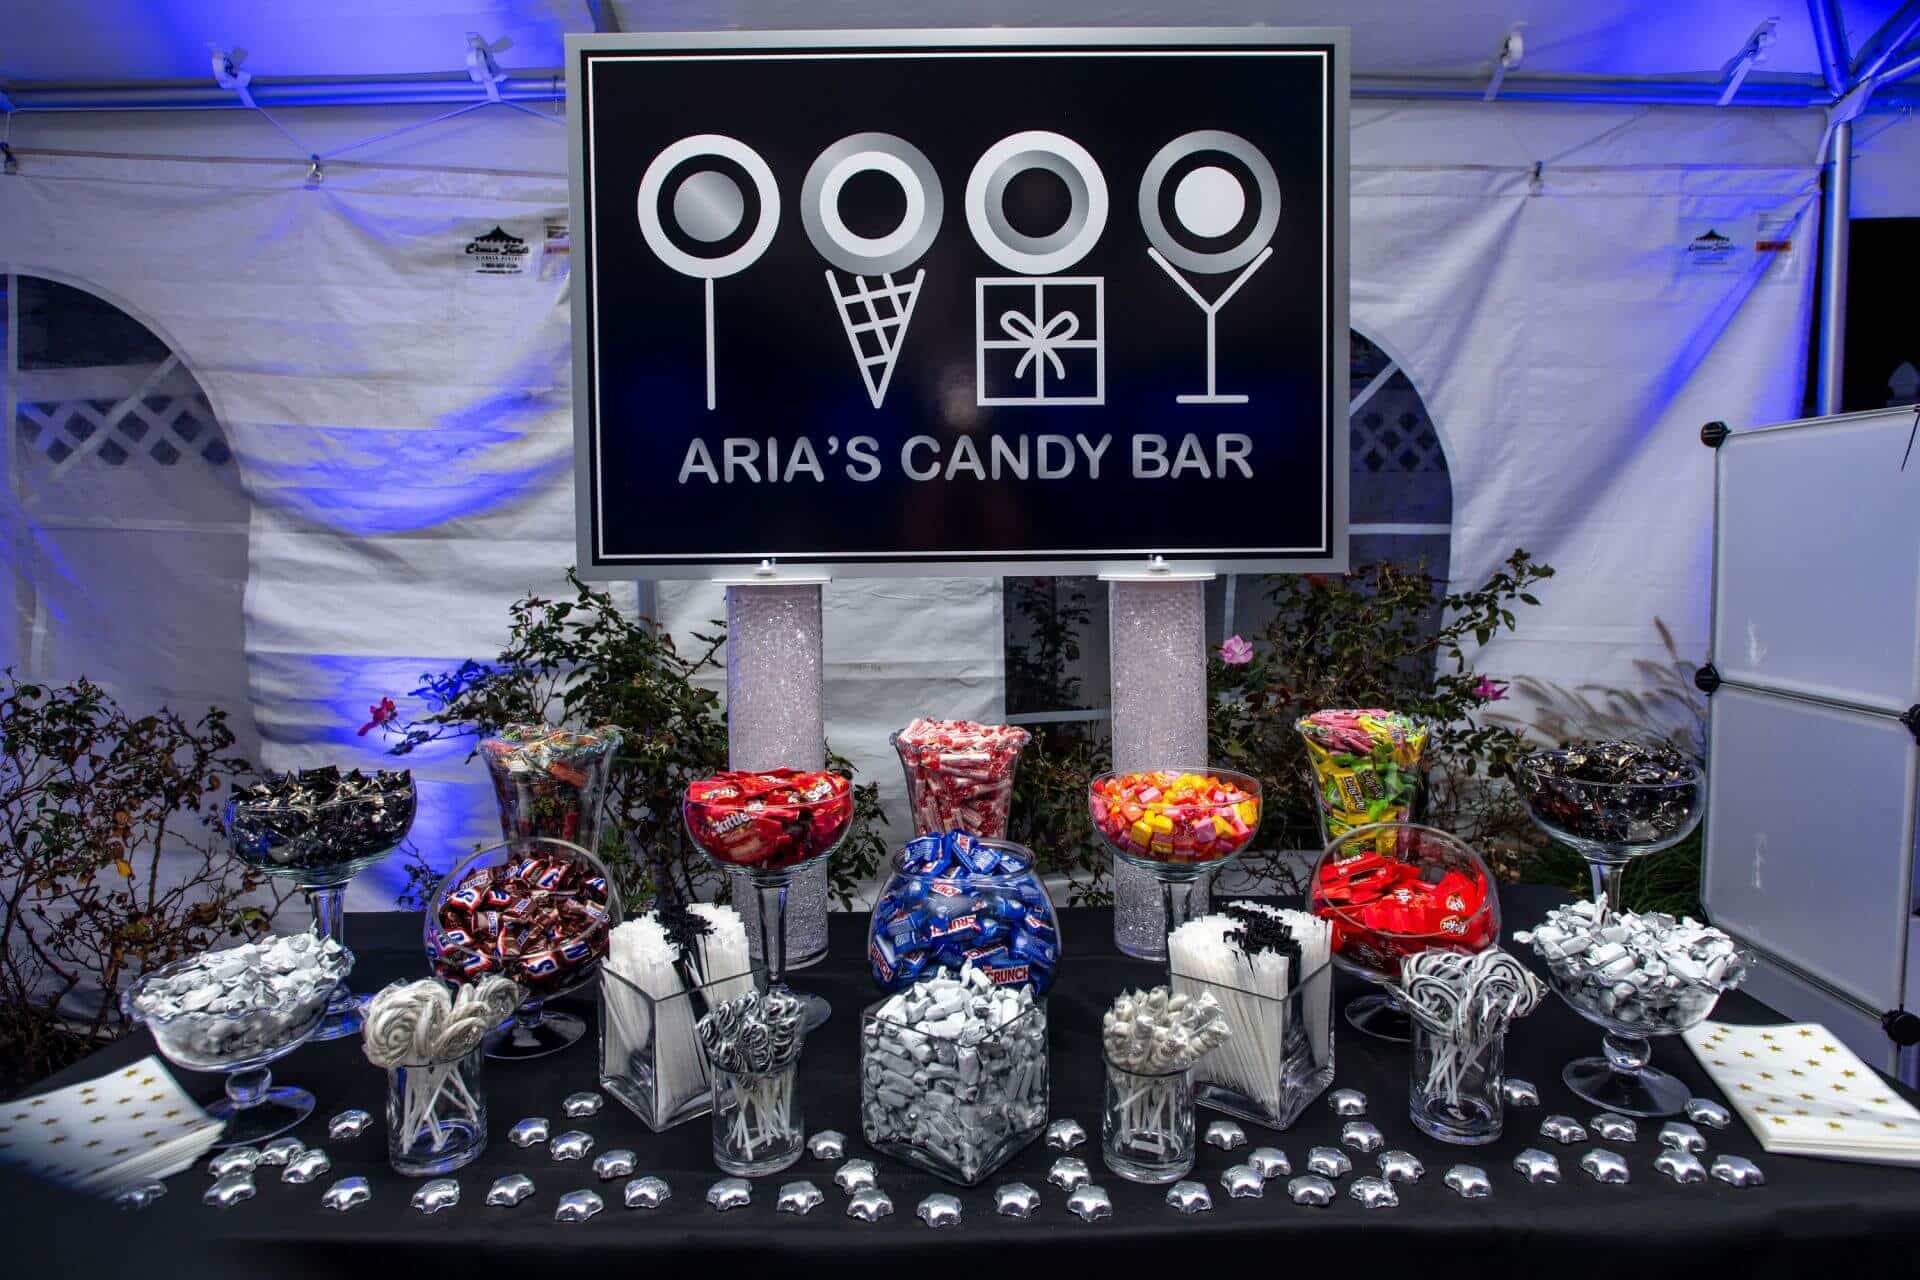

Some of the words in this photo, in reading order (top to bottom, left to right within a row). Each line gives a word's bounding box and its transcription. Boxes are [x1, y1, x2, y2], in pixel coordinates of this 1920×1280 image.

[679, 436, 881, 483] ARIA'S
[901, 434, 1112, 480] CANDY
[1133, 434, 1253, 478] BAR
[989, 967, 1030, 984] CRUNCH
